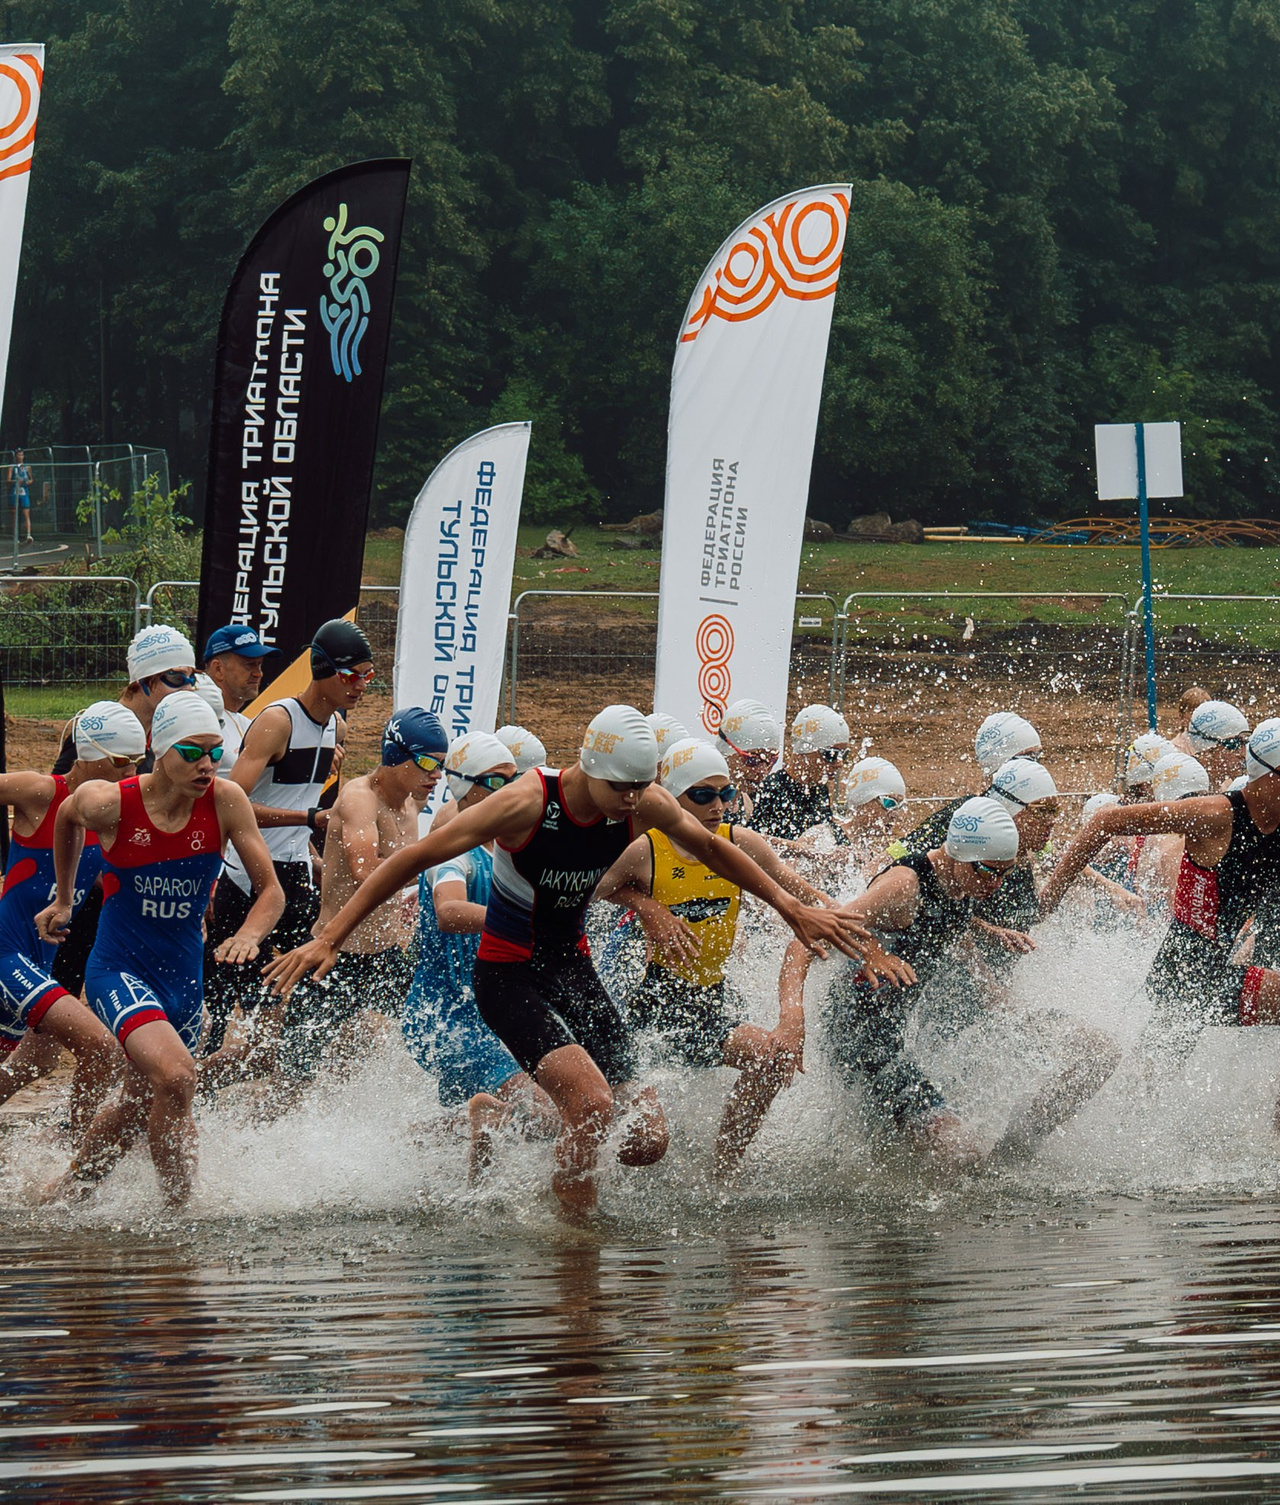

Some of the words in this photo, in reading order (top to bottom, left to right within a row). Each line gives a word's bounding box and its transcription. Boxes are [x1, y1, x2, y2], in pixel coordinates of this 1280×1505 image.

[242, 272, 281, 469] ТРИАТЛОНА
[272, 309, 307, 464] ОБЛАСТИ
[230, 481, 260, 626] ДЕРАЦИЯ
[258, 476, 293, 646] ТУЛЬСКОЙ
[433, 500, 462, 662] ТУЛЬСКОЙ
[460, 461, 497, 653] ФЕДЕРАЦИЯ
[700, 457, 725, 587] ФЕДЕРАЦИЯ
[714, 460, 740, 589] ТРИАТЛОНА
[729, 506, 748, 590] РОССИИ
[430, 674, 450, 715] ОБ
[134, 874, 203, 897] SAPAROV
[141, 898, 192, 920] RUS
[554, 892, 585, 909] RUS
[11, 968, 35, 991] TITAN
[108, 989, 123, 1012] TITAN
